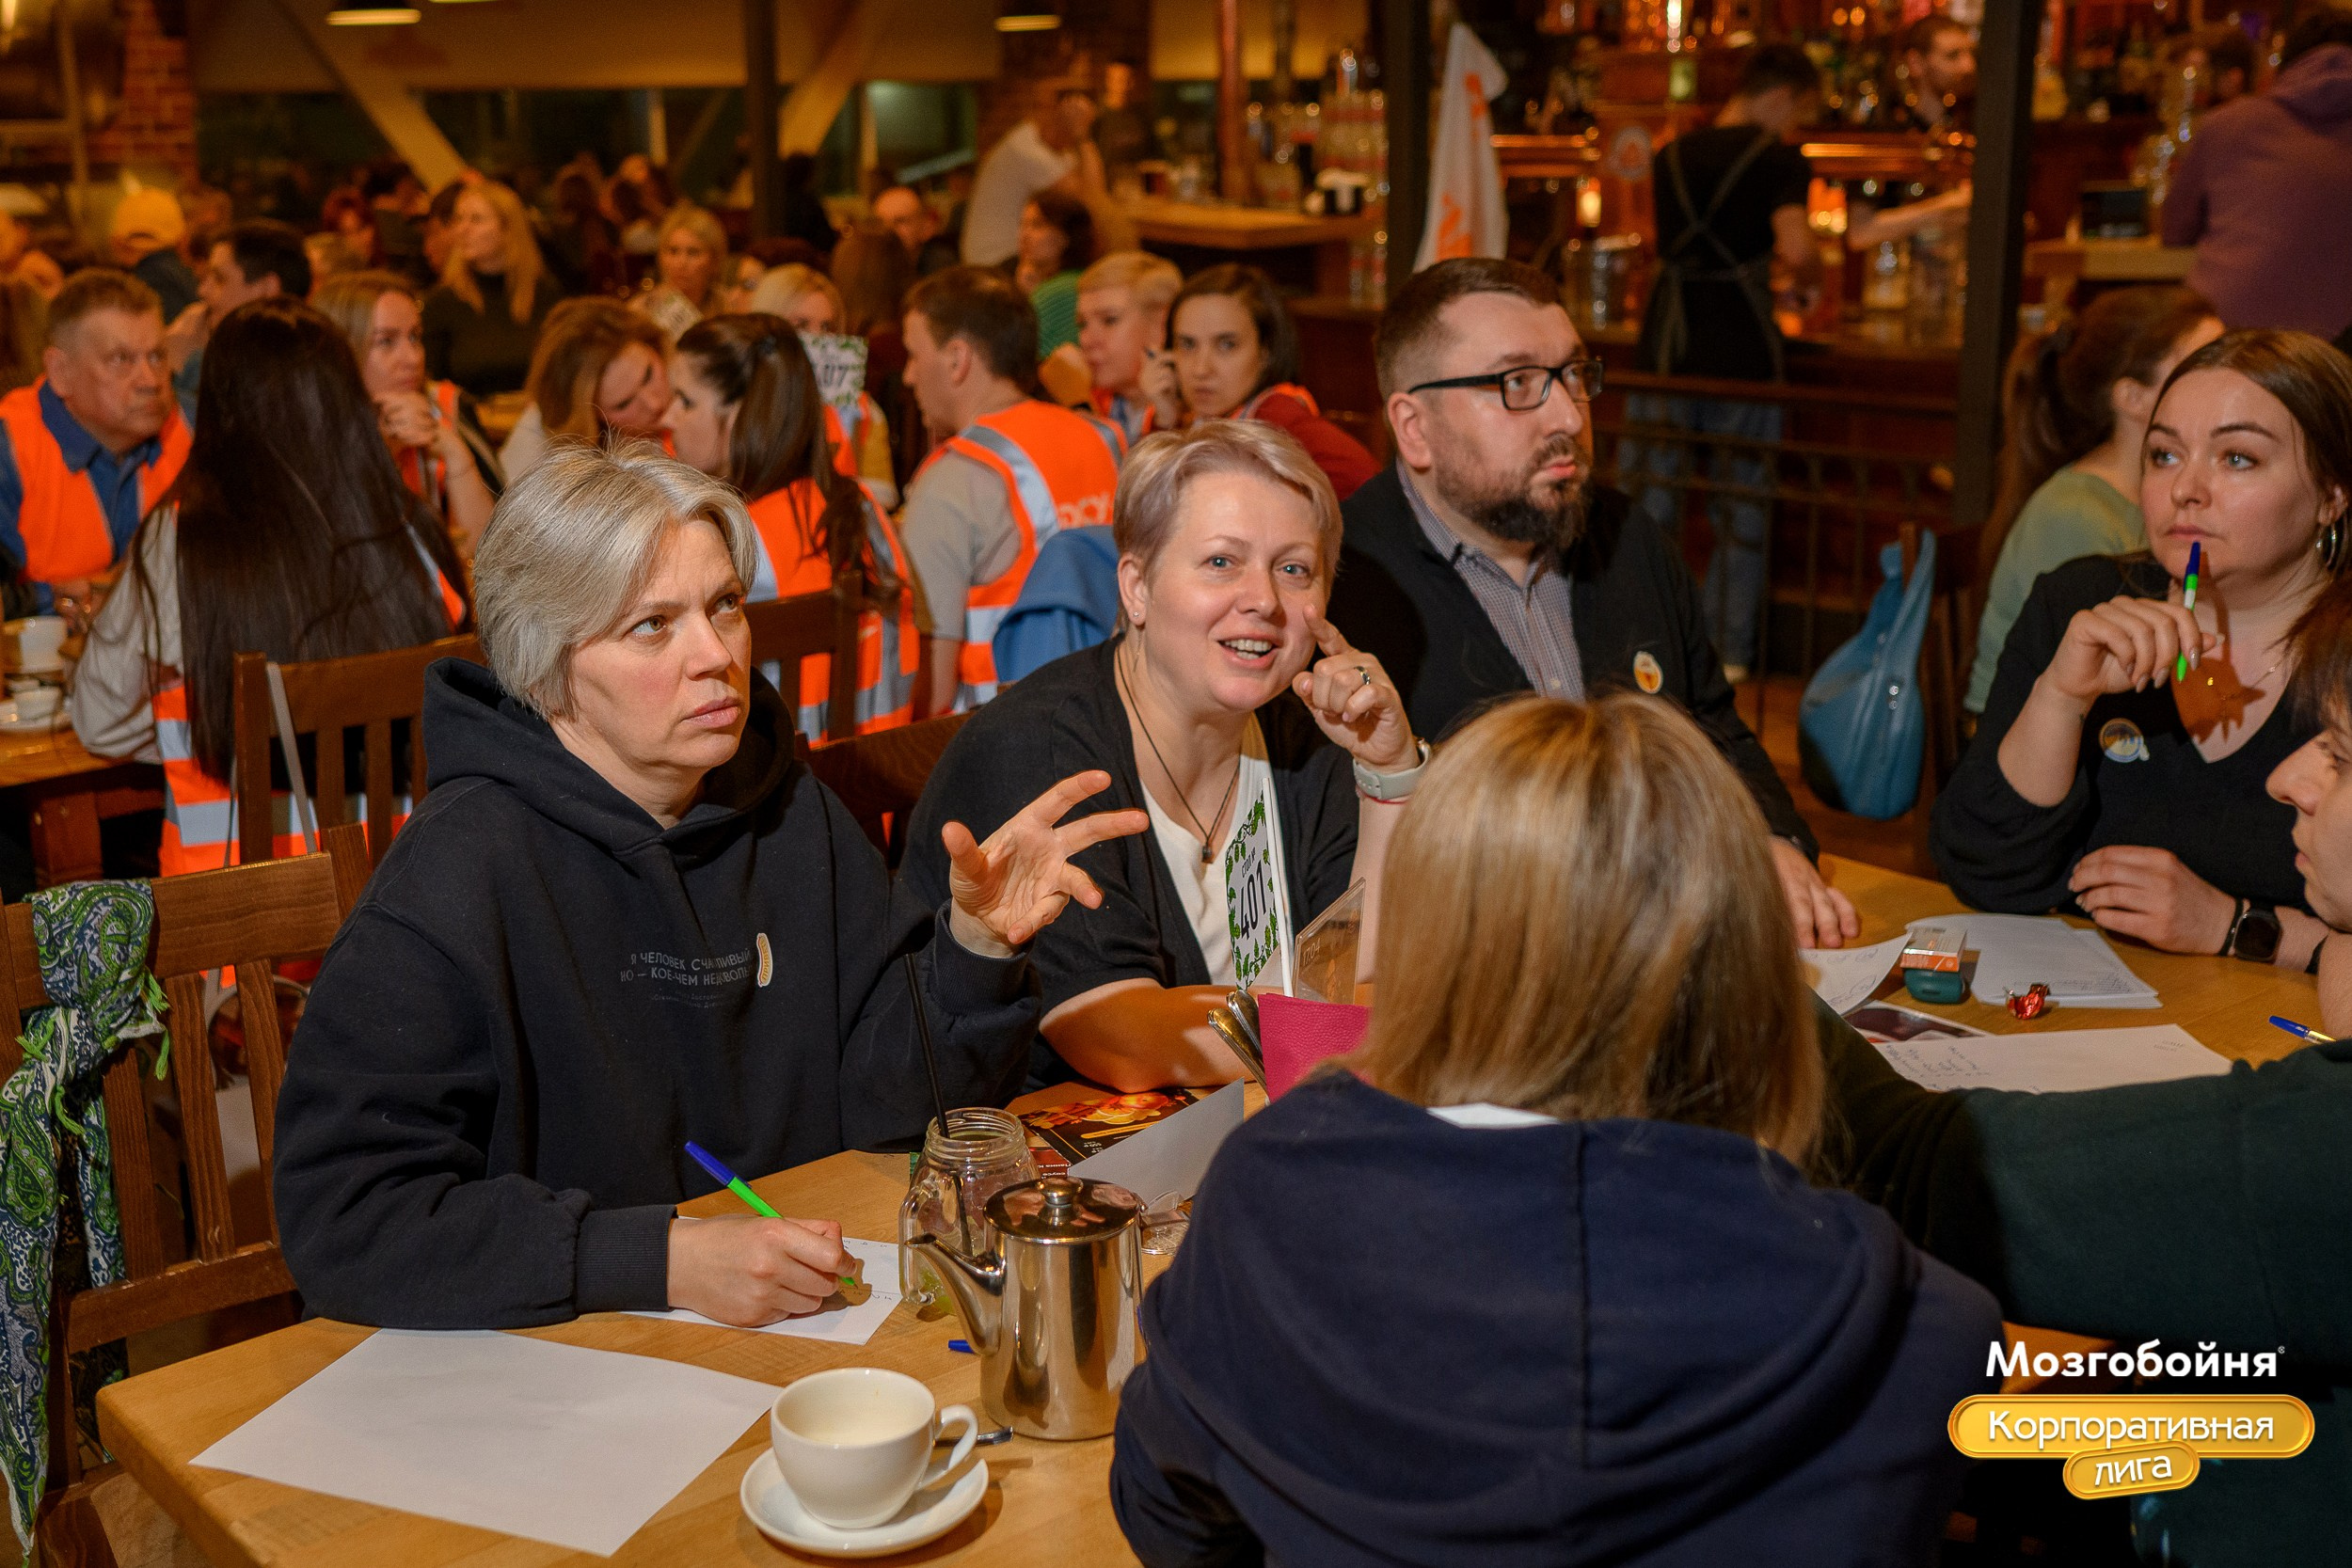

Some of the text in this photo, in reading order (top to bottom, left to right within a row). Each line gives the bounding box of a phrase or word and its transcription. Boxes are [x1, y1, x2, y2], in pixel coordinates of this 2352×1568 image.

[1241, 860, 1266, 941] 401
[630, 948, 752, 971] Я ЧЕЛОВЕК СЧАЛИВЫЙ
[620, 969, 634, 982] НО
[651, 967, 698, 986] КОЕ-ЧЕМ
